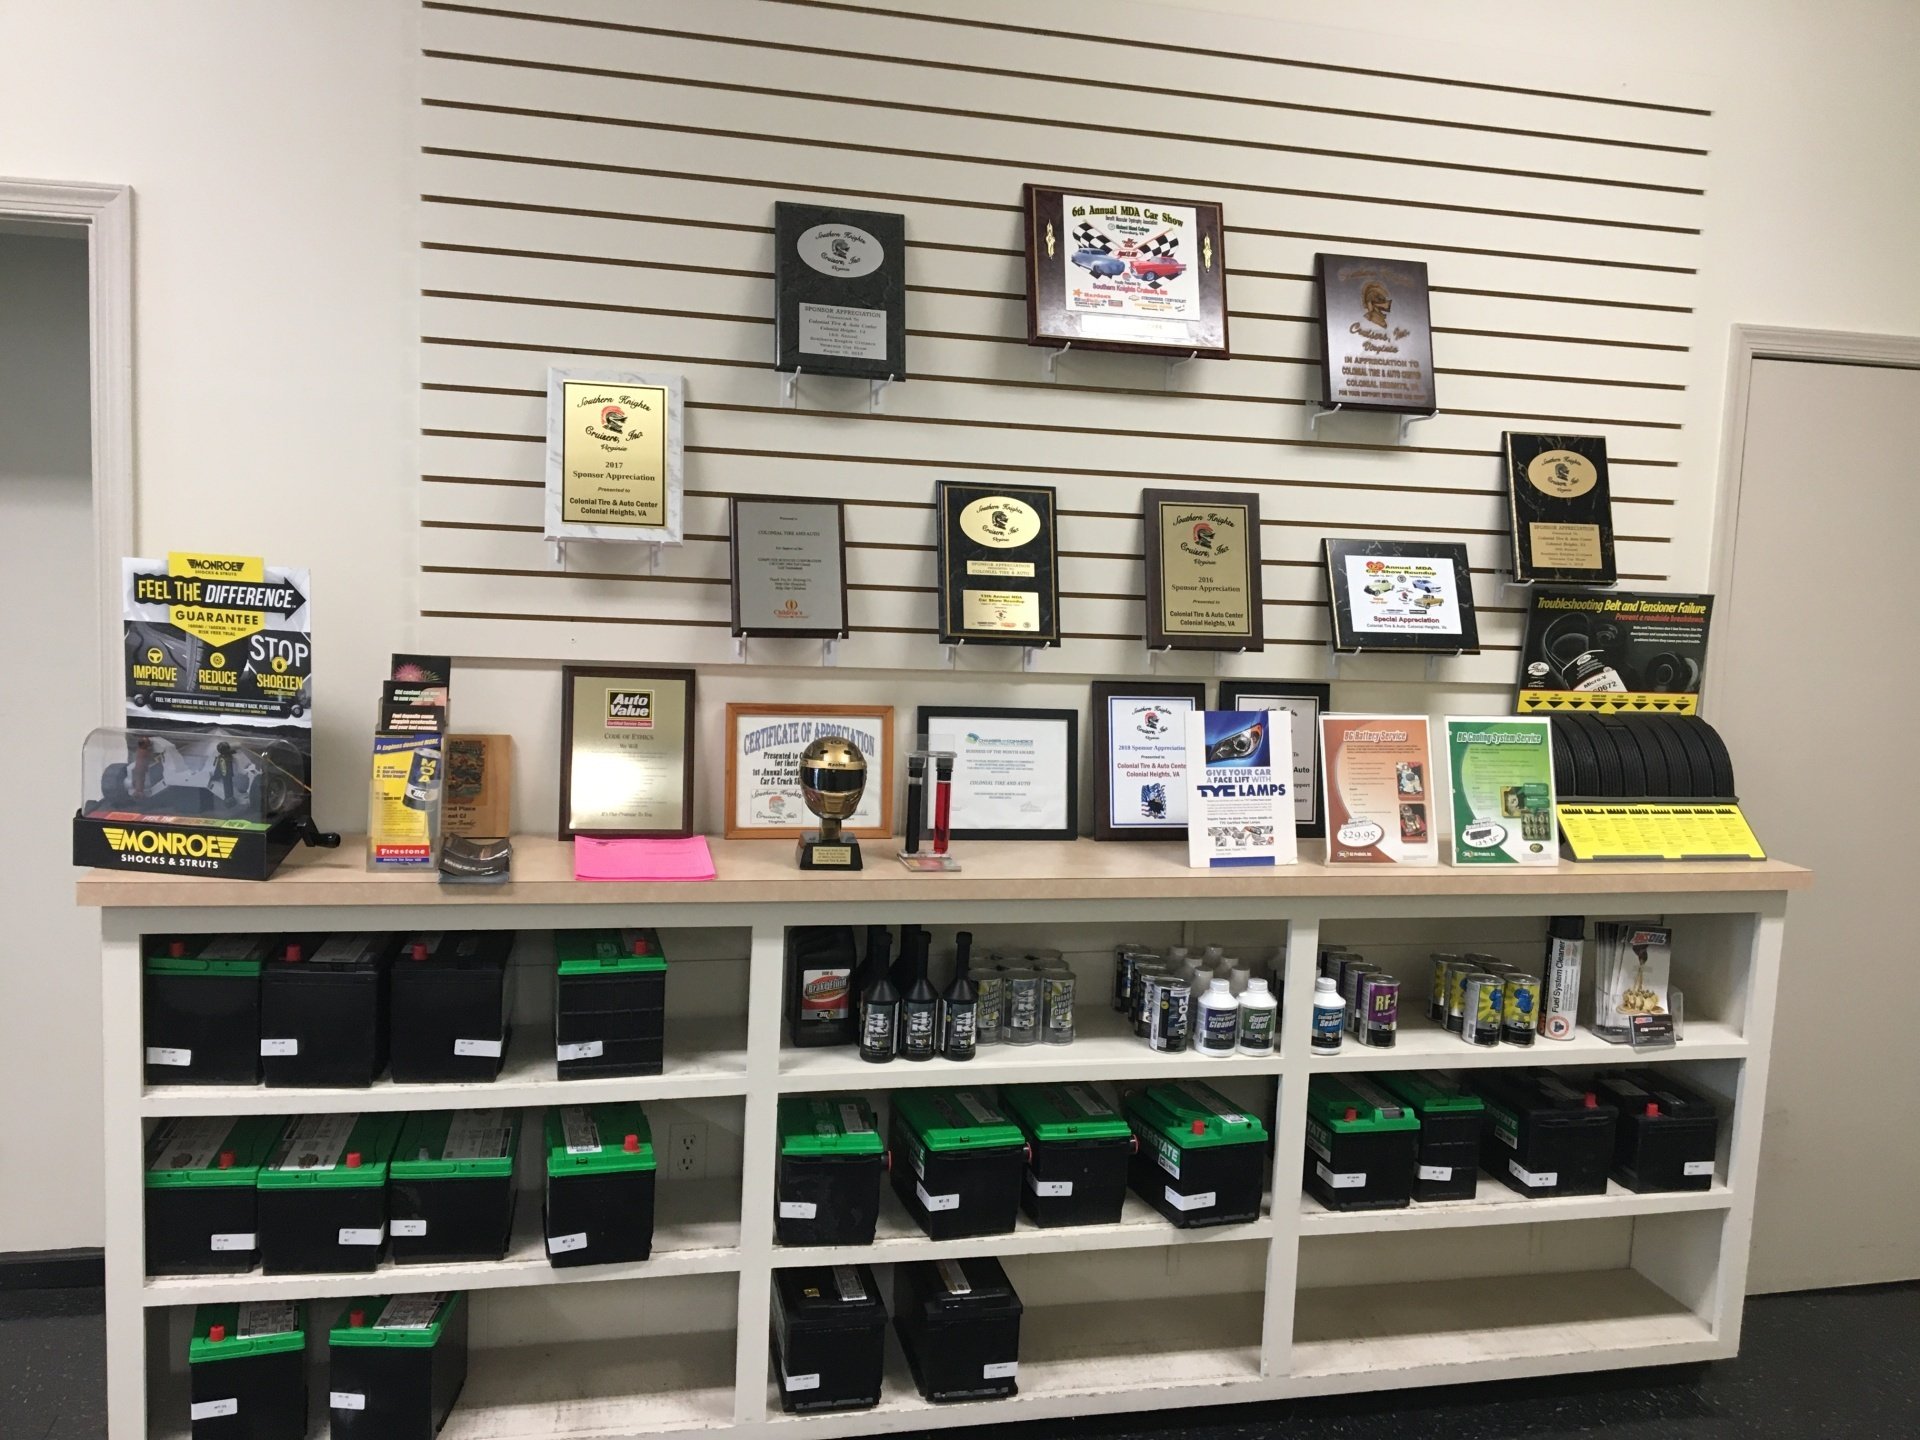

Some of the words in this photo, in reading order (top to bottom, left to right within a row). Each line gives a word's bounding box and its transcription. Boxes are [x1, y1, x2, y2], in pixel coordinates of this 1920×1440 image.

[1072, 206, 1085, 216] 6th
[1089, 205, 1117, 215] Annual
[1120, 206, 1140, 216] MDA
[1144, 208, 1158, 220] Car
[1162, 212, 1184, 228] Show
[1092, 282, 1116, 291] Southern
[804, 305, 834, 314] SPONSOR
[835, 308, 882, 318] APPRECIATION
[1354, 356, 1407, 368] APPRECIATION
[1409, 360, 1420, 368] TO
[577, 394, 614, 408] Southern
[618, 394, 652, 412] Knights
[585, 425, 620, 444] Cruisers,
[600, 443, 628, 452] Virginia
[605, 461, 623, 469] 2017
[572, 470, 604, 480] Sponsor
[605, 472, 656, 482] Appreciation
[570, 498, 597, 506] Colonial
[636, 500, 658, 508] Center
[976, 504, 1000, 514] Southern
[1002, 503, 1024, 514] Knights
[580, 507, 608, 515] Colonial
[610, 508, 636, 518] Heights,
[638, 509, 647, 517] VA
[1172, 512, 1204, 526] Southern
[1208, 513, 1235, 528] Knights
[1180, 542, 1210, 558] Cruisers,
[189, 559, 242, 572] MONROE
[138, 579, 172, 600] FEEL
[174, 580, 202, 602] THE
[204, 584, 294, 608] DIFFERENCE
[1172, 584, 1198, 592] Sponsor
[1198, 585, 1240, 594] Appreciation
[1538, 597, 1604, 614] Troubleshooting
[1604, 599, 1622, 612] Belt
[1622, 600, 1640, 612] and
[1640, 600, 1678, 614] Tensioner
[1678, 602, 1706, 615] Failure
[176, 610, 259, 626] GUARANTEE
[1374, 616, 1398, 624] Special
[1398, 616, 1440, 624] Appreciation
[1615, 612, 1639, 620] Prevent
[1204, 620, 1227, 628] Heights,
[250, 634, 309, 668] STOP
[133, 664, 178, 681] IMPROVE
[198, 669, 238, 686] REDUCE
[256, 673, 303, 690] SHORTEN
[1583, 674, 1607, 689] Micro-V
[612, 693, 648, 706] Auto
[610, 704, 649, 717] Value
[1132, 706, 1152, 716] Southern
[1153, 705, 1172, 715] Knights
[744, 722, 800, 756] CERTIFICATE
[800, 722, 812, 743] OF
[814, 722, 875, 757] APPRECIATION
[1355, 730, 1381, 744] Battery
[1380, 731, 1408, 742] Service
[1468, 732, 1492, 744] Cooling
[1492, 732, 1516, 744] System
[1516, 733, 1542, 744] Service
[763, 752, 792, 760] Presented
[792, 752, 798, 760] to
[774, 759, 784, 767] for
[784, 759, 798, 767] their
[761, 768, 782, 776] Annual
[1197, 784, 1236, 798] TYC
[1238, 784, 1286, 797] LAMPS
[1342, 830, 1376, 842] $29.95
[110, 828, 232, 859] MONROE
[380, 848, 426, 856] Firestone
[116, 854, 165, 865] SHOCKS
[168, 857, 176, 866] &
[179, 858, 219, 869] STRUTS
[1556, 941, 1566, 969] Cleaner
[1554, 969, 1562, 996] System
[1551, 996, 1560, 1014] Fuel
[1209, 1020, 1236, 1028] Cleaner
[1248, 1015, 1271, 1024] Super
[1250, 1022, 1268, 1030] Cool
[1320, 1019, 1341, 1027] Sealer
